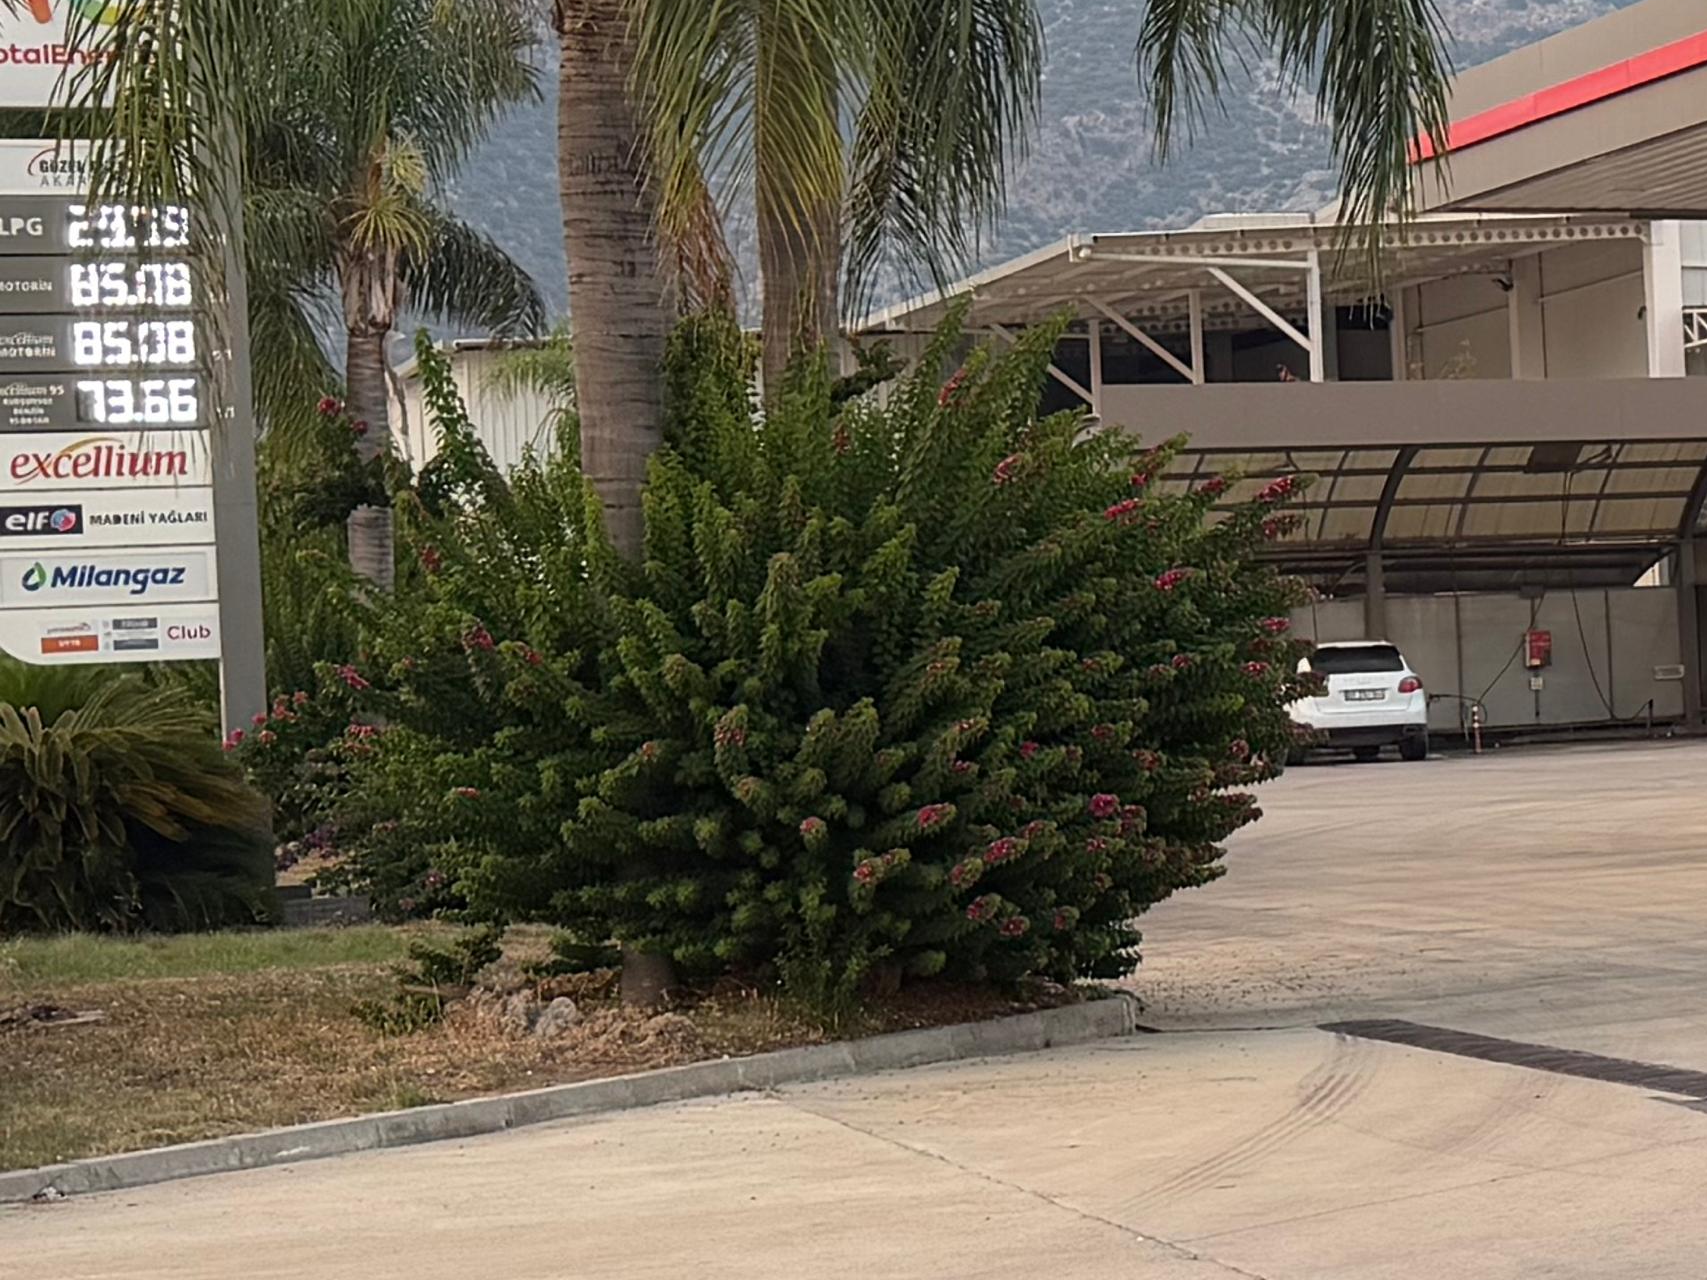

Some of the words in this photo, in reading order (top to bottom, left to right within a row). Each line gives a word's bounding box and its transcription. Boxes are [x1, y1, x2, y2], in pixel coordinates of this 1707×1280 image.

[0, 217, 43, 236] LPG
[76, 379, 197, 423] 73.66
[10, 444, 188, 480] excellium
[5, 511, 49, 532] elf
[90, 510, 145, 526] MADENİ
[149, 509, 208, 524] YAĞLARI
[51, 565, 186, 595] Milangaz
[167, 625, 211, 640] Club
